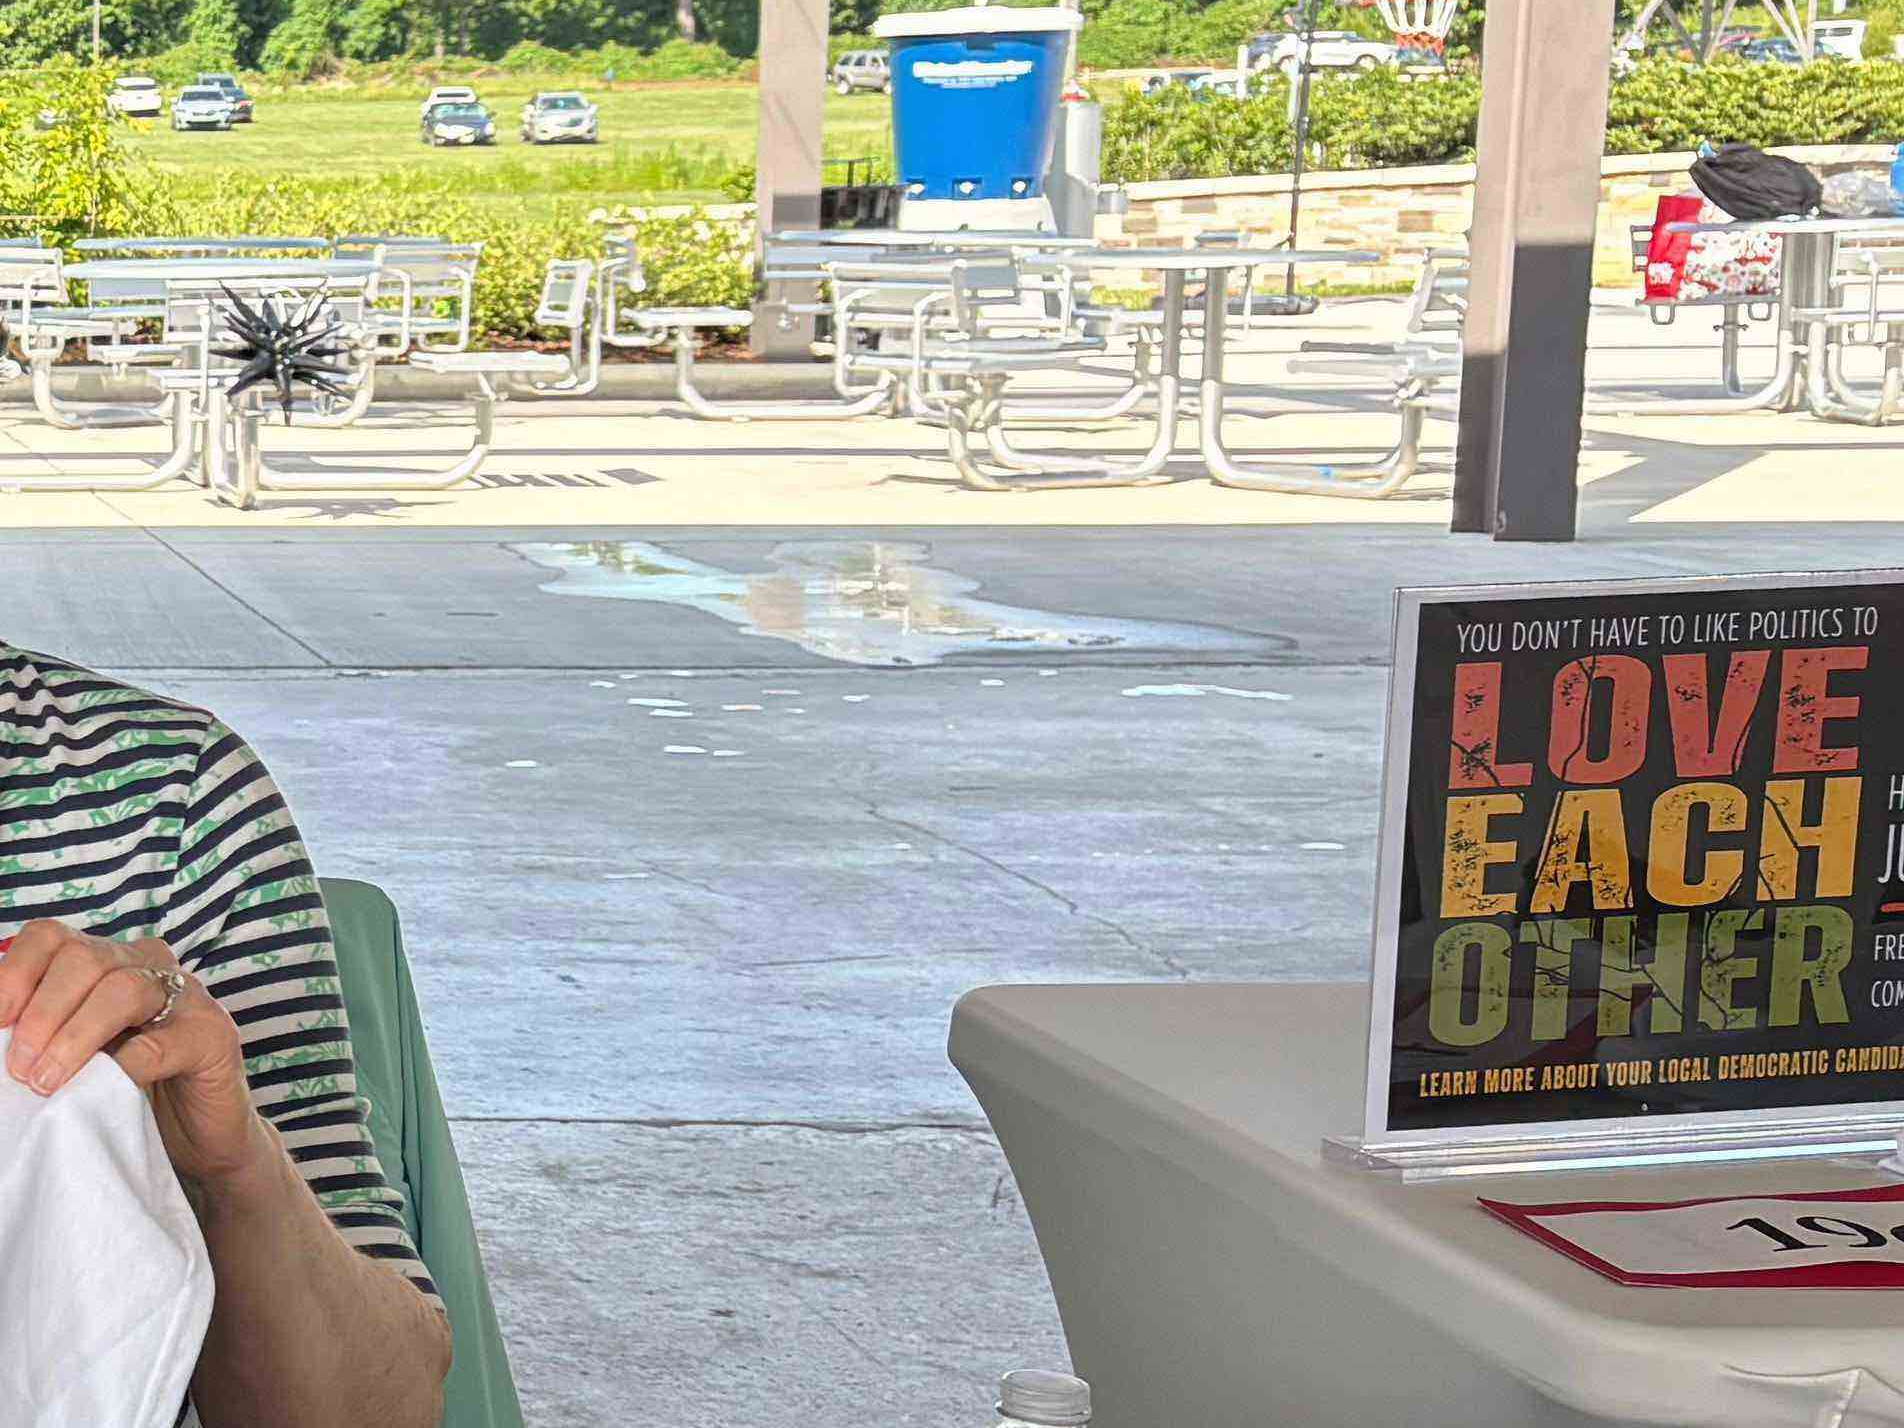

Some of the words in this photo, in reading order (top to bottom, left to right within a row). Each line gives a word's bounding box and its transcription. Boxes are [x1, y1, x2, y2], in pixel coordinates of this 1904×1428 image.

[1456, 622, 1502, 654] YOU
[1511, 617, 1583, 652] DON'T
[1590, 615, 1651, 649] HAVE
[1658, 613, 1685, 646] TO
[1693, 611, 1741, 644] LIKE
[1749, 606, 1844, 641] POLITICS
[1852, 605, 1879, 638] TO
[1448, 646, 1870, 790] LOVE
[1440, 776, 1863, 919] EACH
[1428, 905, 1856, 1047] OTHER
[1419, 1069, 1478, 1098] LEARN
[1483, 1066, 1536, 1094] MORE
[1540, 1062, 1600, 1091] ABOUT
[1605, 1059, 1653, 1088] YOUR
[1658, 1056, 1712, 1085] LOCAL
[1718, 1050, 1829, 1082] DEMOCRATIC
[1726, 1216, 1904, 1253] 19
